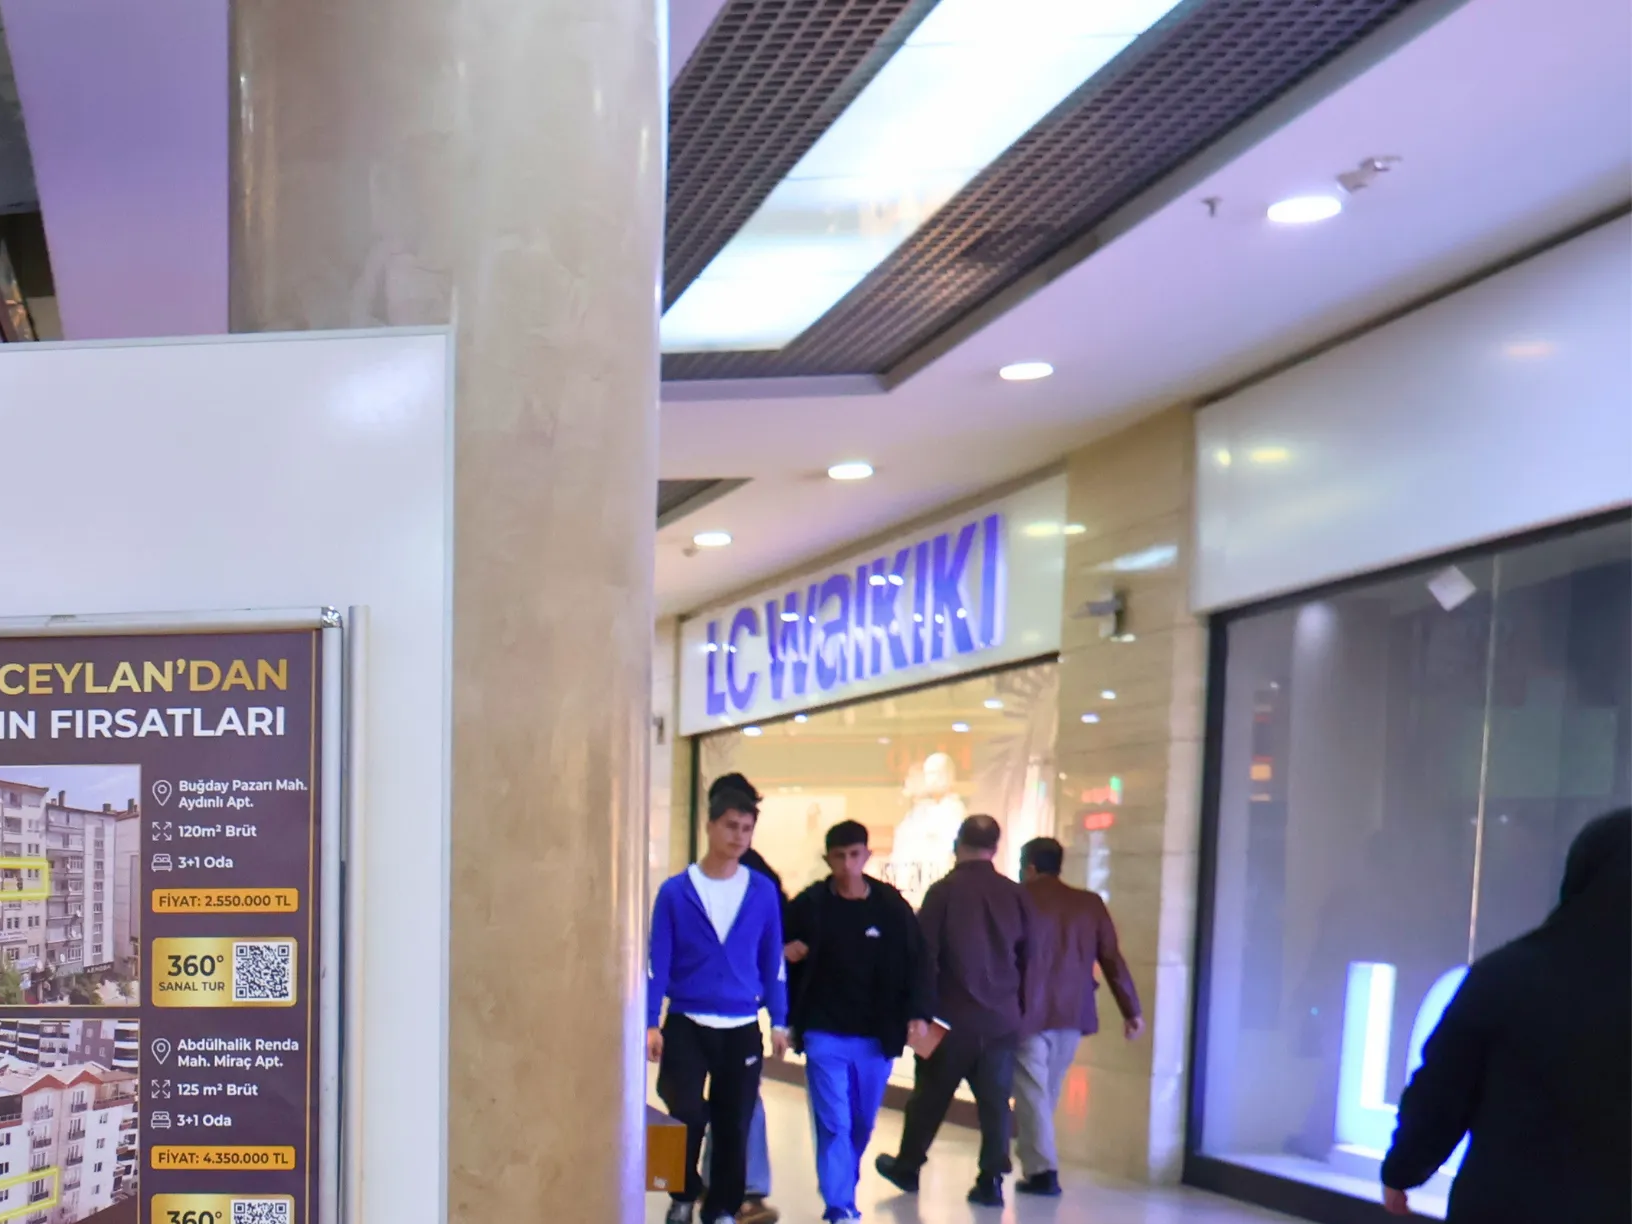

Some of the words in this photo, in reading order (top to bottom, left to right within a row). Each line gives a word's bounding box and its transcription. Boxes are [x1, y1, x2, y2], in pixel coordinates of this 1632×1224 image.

[50, 706, 285, 739] FIRSATLARI
[178, 780, 229, 794] Buğday
[232, 779, 272, 791] Pazarı
[276, 778, 308, 791] Mah.
[178, 796, 224, 811] Aydınlı
[226, 796, 254, 810] Apt.
[225, 824, 257, 837] Brüt
[178, 857, 200, 869] 3+1
[204, 856, 234, 869] Oda
[159, 893, 201, 907] FİYAT:
[205, 896, 271, 907] 2.550.000
[275, 895, 291, 906] TL
[167, 955, 224, 977] 360°
[159, 981, 198, 992] SANAL
[201, 981, 225, 992] TUR
[177, 1038, 252, 1052] Abdülhalik
[255, 1038, 299, 1051] Renda
[177, 1055, 211, 1067] Mah.
[214, 1055, 252, 1070] Miraç
[254, 1055, 284, 1069] Apt.
[177, 1084, 199, 1096] 125
[203, 1083, 223, 1096] m²
[227, 1083, 258, 1096] Brüt
[176, 1115, 199, 1127] 3+1
[202, 1114, 232, 1127] Oda
[158, 1150, 200, 1164] FİYAT:
[203, 1152, 269, 1164] 4.350.000
[273, 1152, 289, 1164] TL
